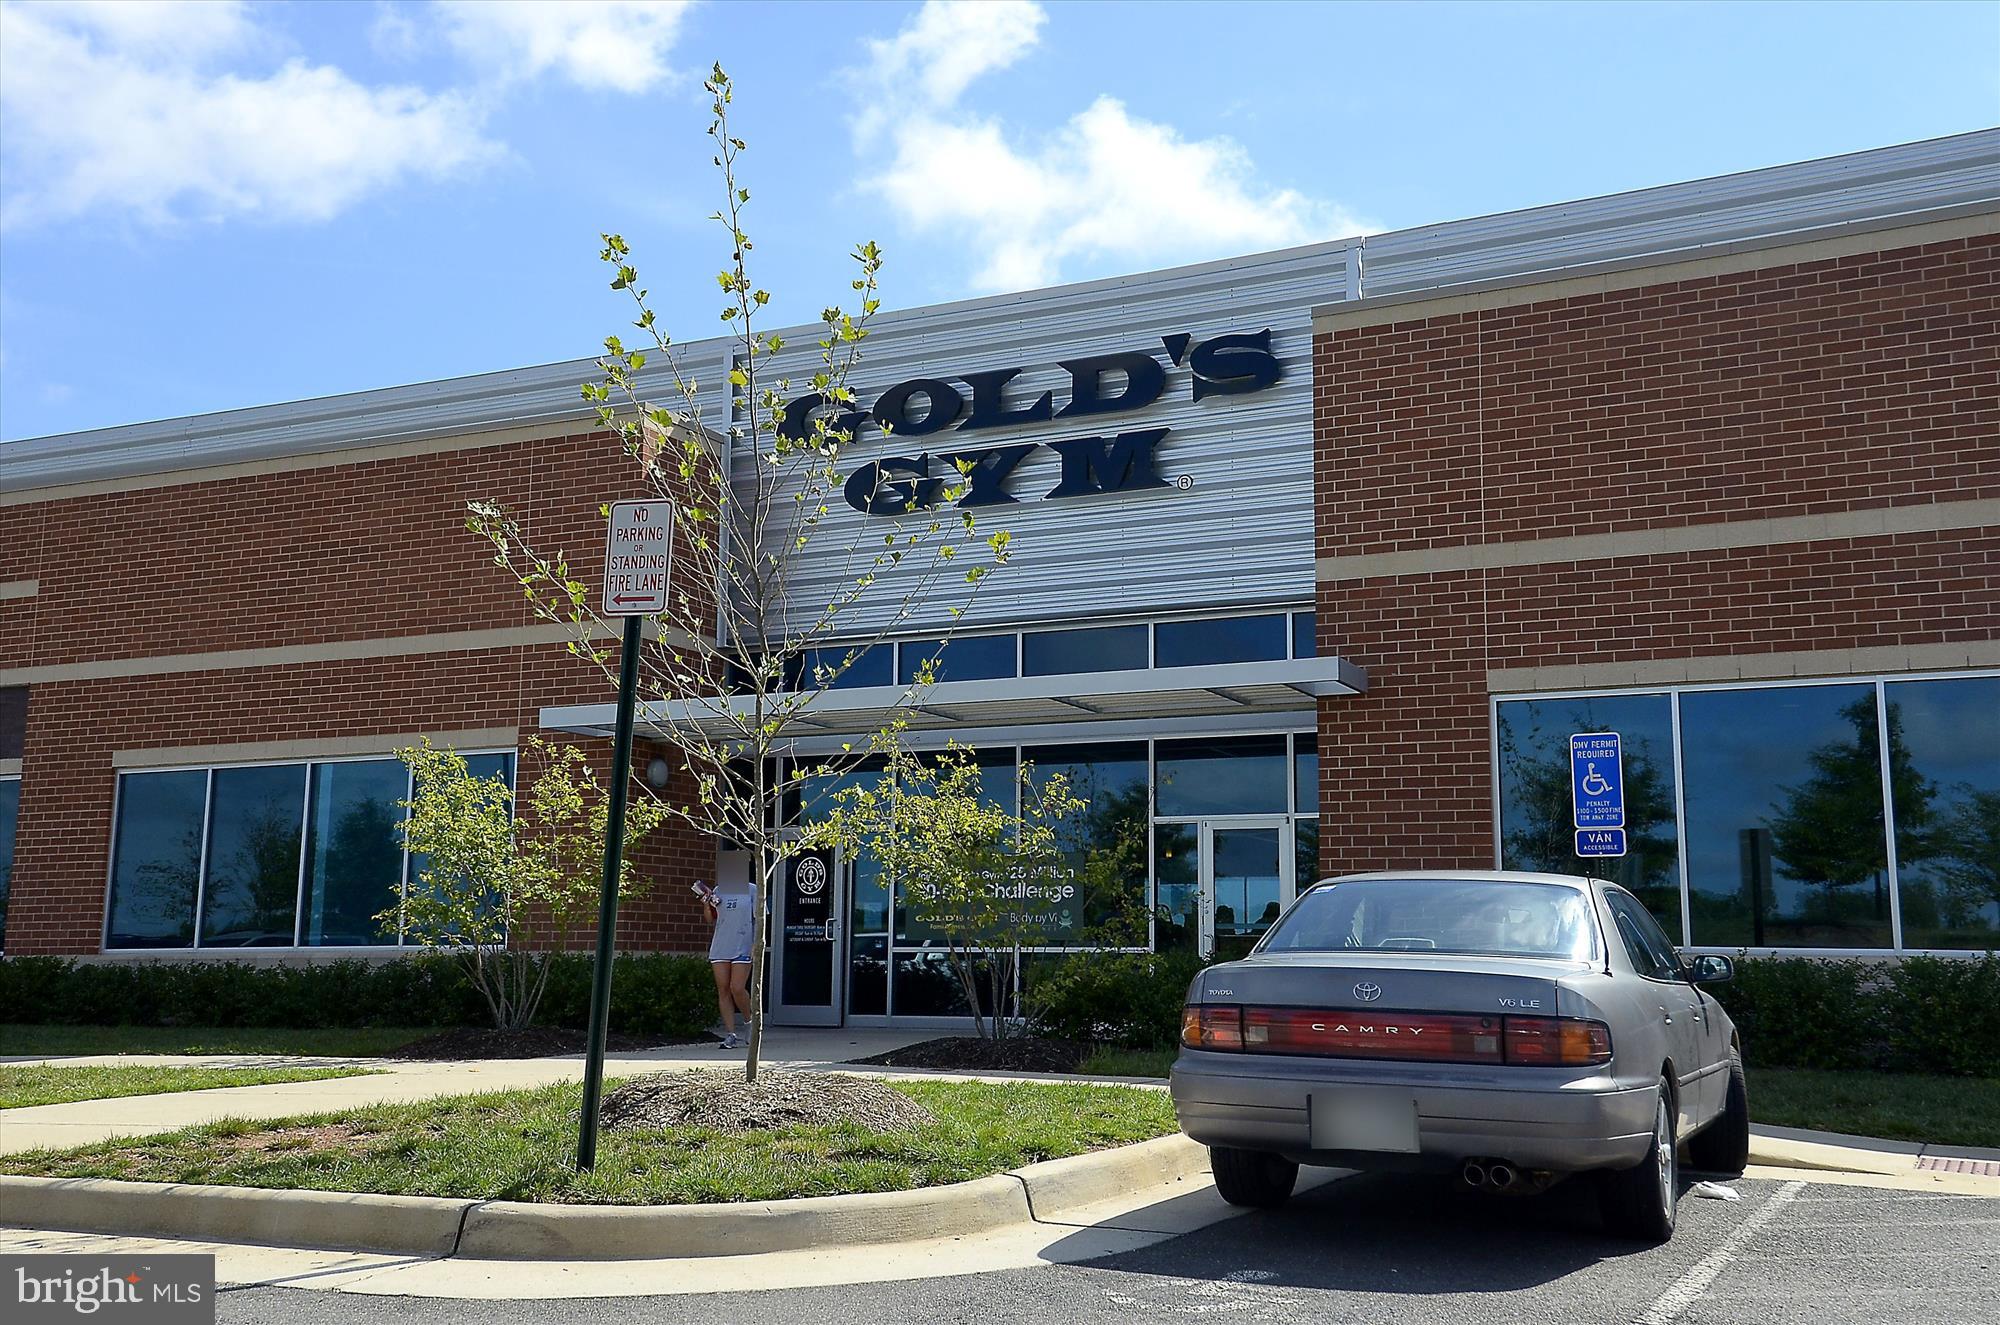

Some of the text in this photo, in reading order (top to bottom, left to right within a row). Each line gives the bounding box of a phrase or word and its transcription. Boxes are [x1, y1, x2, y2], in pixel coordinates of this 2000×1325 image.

[777, 328, 1281, 447] GOLD'S
[844, 427, 1174, 515] GYM
[633, 508, 649, 523] NO
[616, 527, 664, 542] PARKING
[633, 544, 644, 552] OR
[611, 555, 665, 570] STANDING
[609, 573, 664, 592] FIRE LANE
[1573, 740, 1618, 749] DMV PERMIT
[1577, 749, 1615, 759] REQUIRED
[1588, 833, 1612, 843] VAN
[1498, 998, 1540, 1008] V6 LE
[1311, 1023, 1424, 1035] CAMRY
